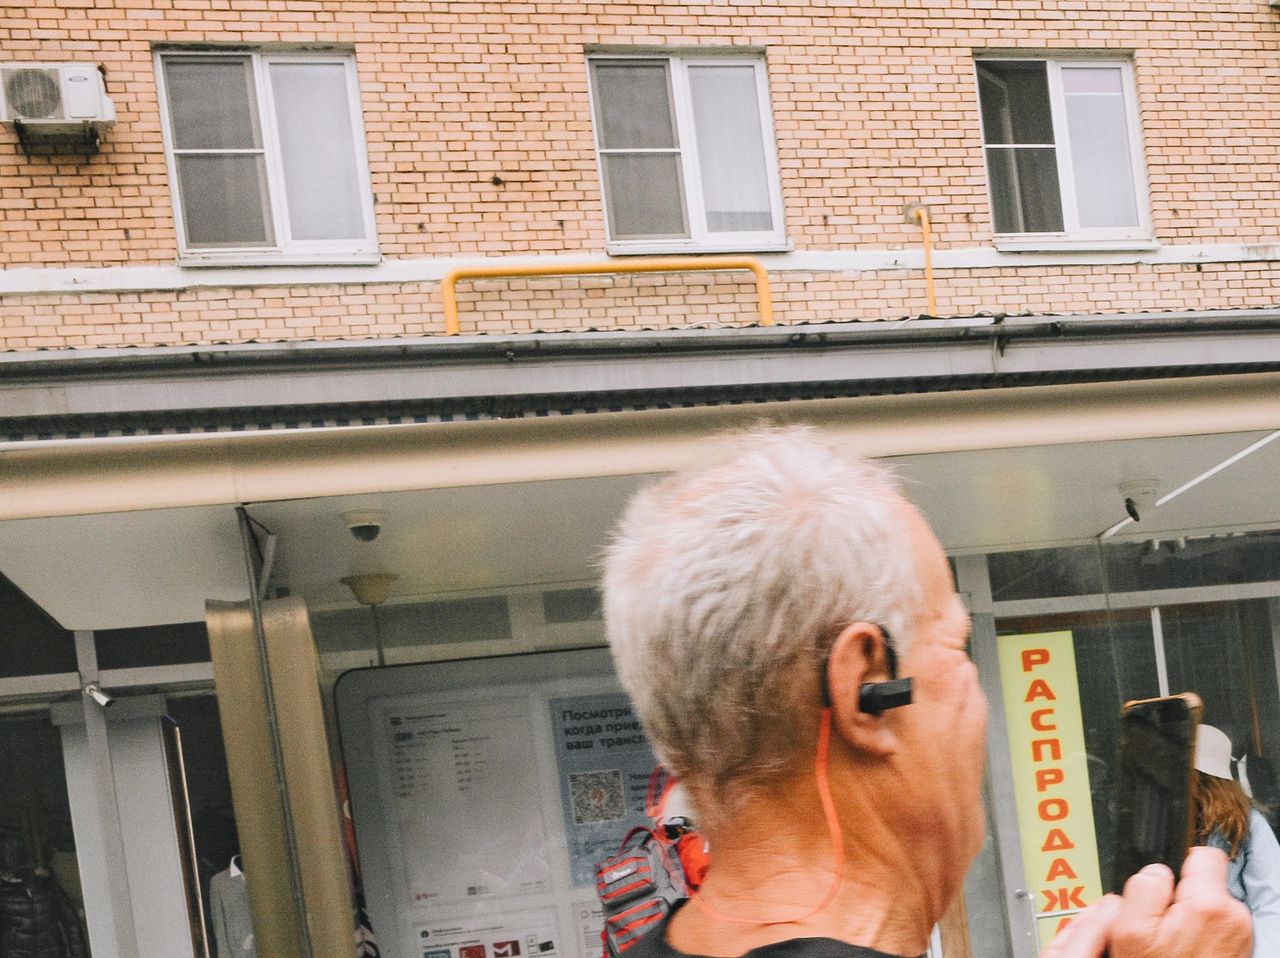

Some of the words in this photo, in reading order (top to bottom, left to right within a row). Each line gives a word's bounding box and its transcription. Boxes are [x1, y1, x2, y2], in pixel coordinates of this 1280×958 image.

[564, 724, 602, 736] когда
[606, 721, 643, 734] прие
[566, 740, 593, 750] ваш
